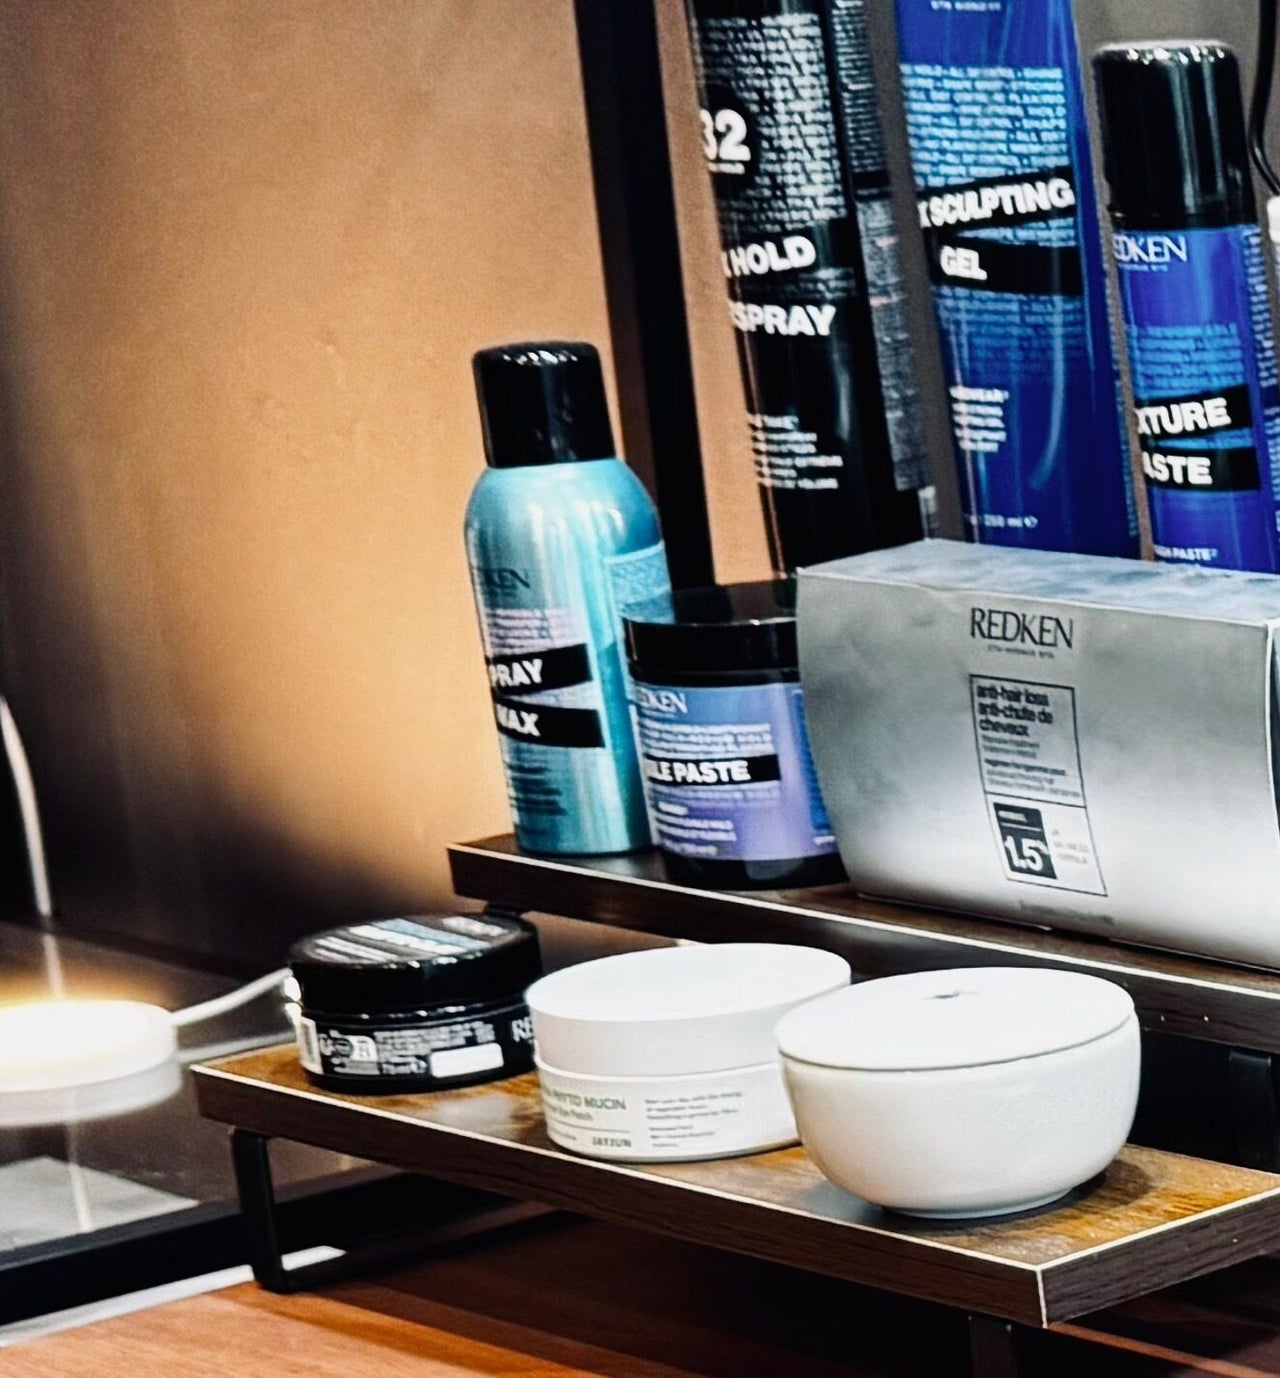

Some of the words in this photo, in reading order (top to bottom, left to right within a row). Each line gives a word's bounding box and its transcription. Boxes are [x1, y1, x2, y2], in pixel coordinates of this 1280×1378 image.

[930, 177, 1076, 227] SCULPTING
[731, 235, 817, 276] HOLD
[939, 245, 988, 280] GEL
[728, 300, 837, 336] SPRAY
[970, 606, 1074, 649] REDKEN
[673, 760, 752, 783] PASTE
